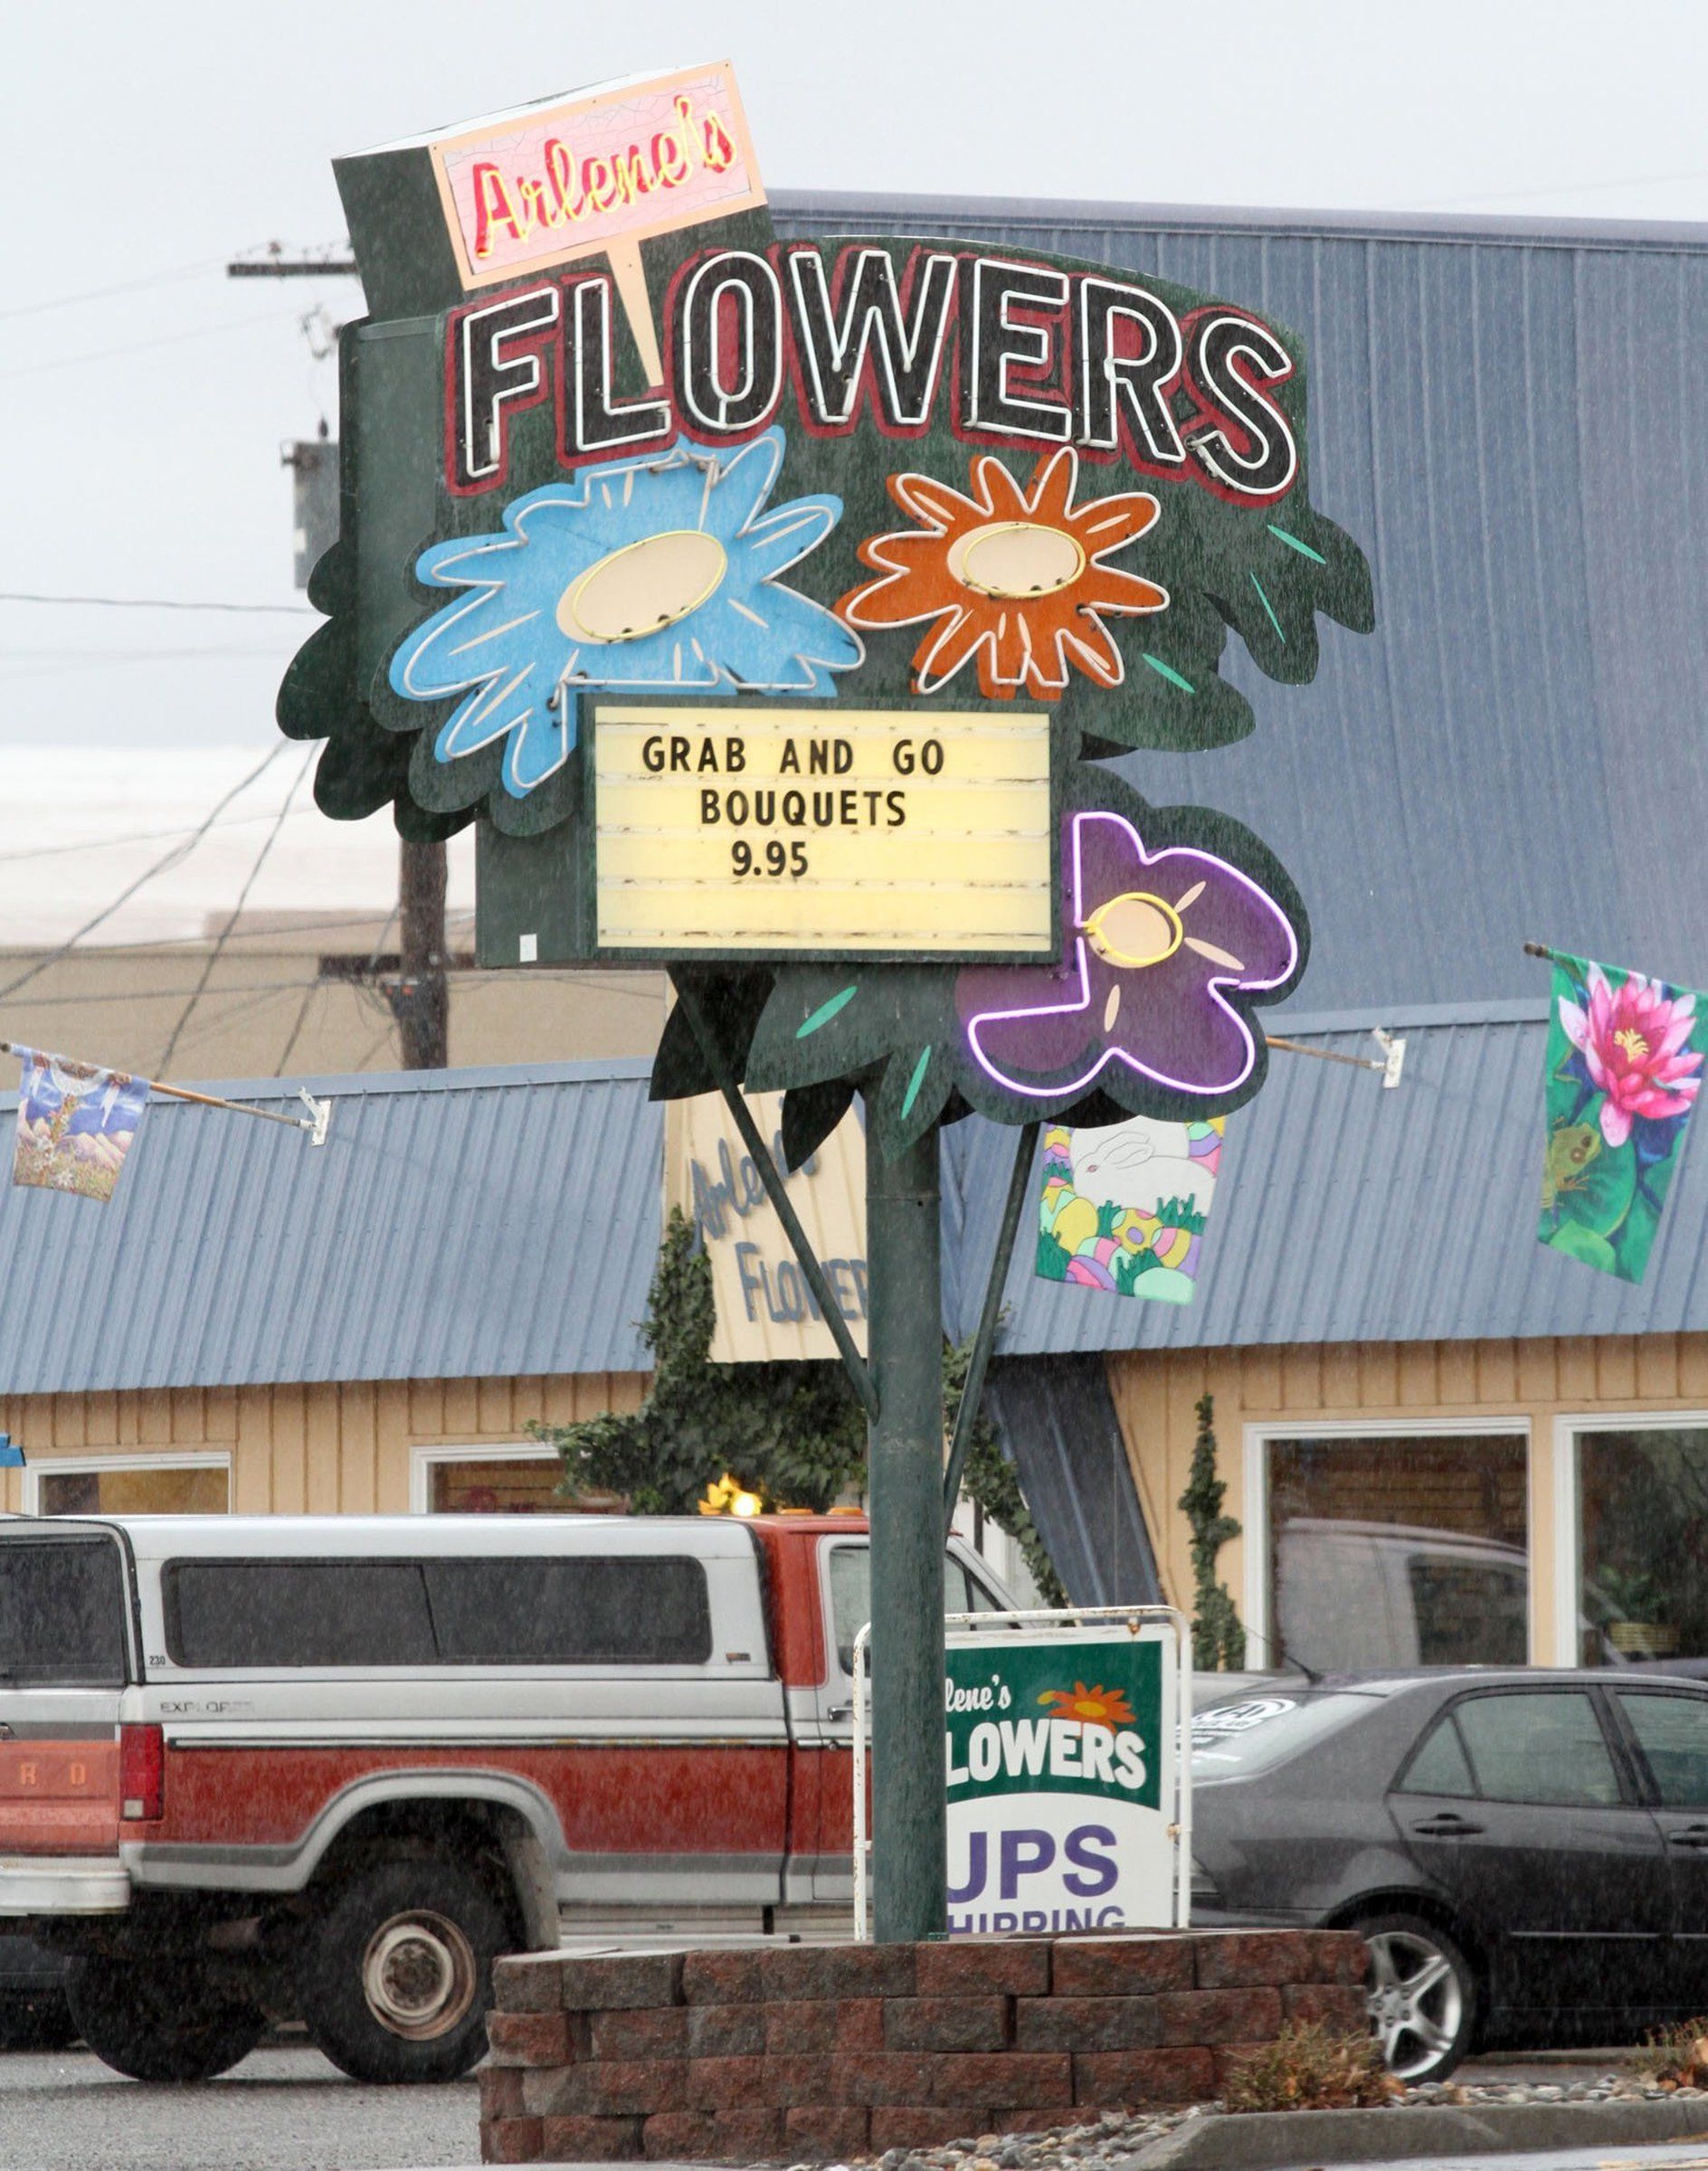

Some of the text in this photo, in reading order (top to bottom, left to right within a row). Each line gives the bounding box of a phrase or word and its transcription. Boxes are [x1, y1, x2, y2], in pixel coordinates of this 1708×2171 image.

[472, 94, 738, 259] Arlene's
[446, 243, 1299, 507] FLOWERS
[641, 735, 945, 776] GRAB AND GO
[700, 789, 906, 827] BOUQUETS
[731, 840, 809, 877] 9.95
[944, 1673, 1012, 1713] lene's
[944, 1718, 1147, 1790] LOWERS
[19, 1762, 87, 1787] RD
[946, 1824, 1120, 1904] UPS
[946, 1905, 1126, 1935] HIPPING
